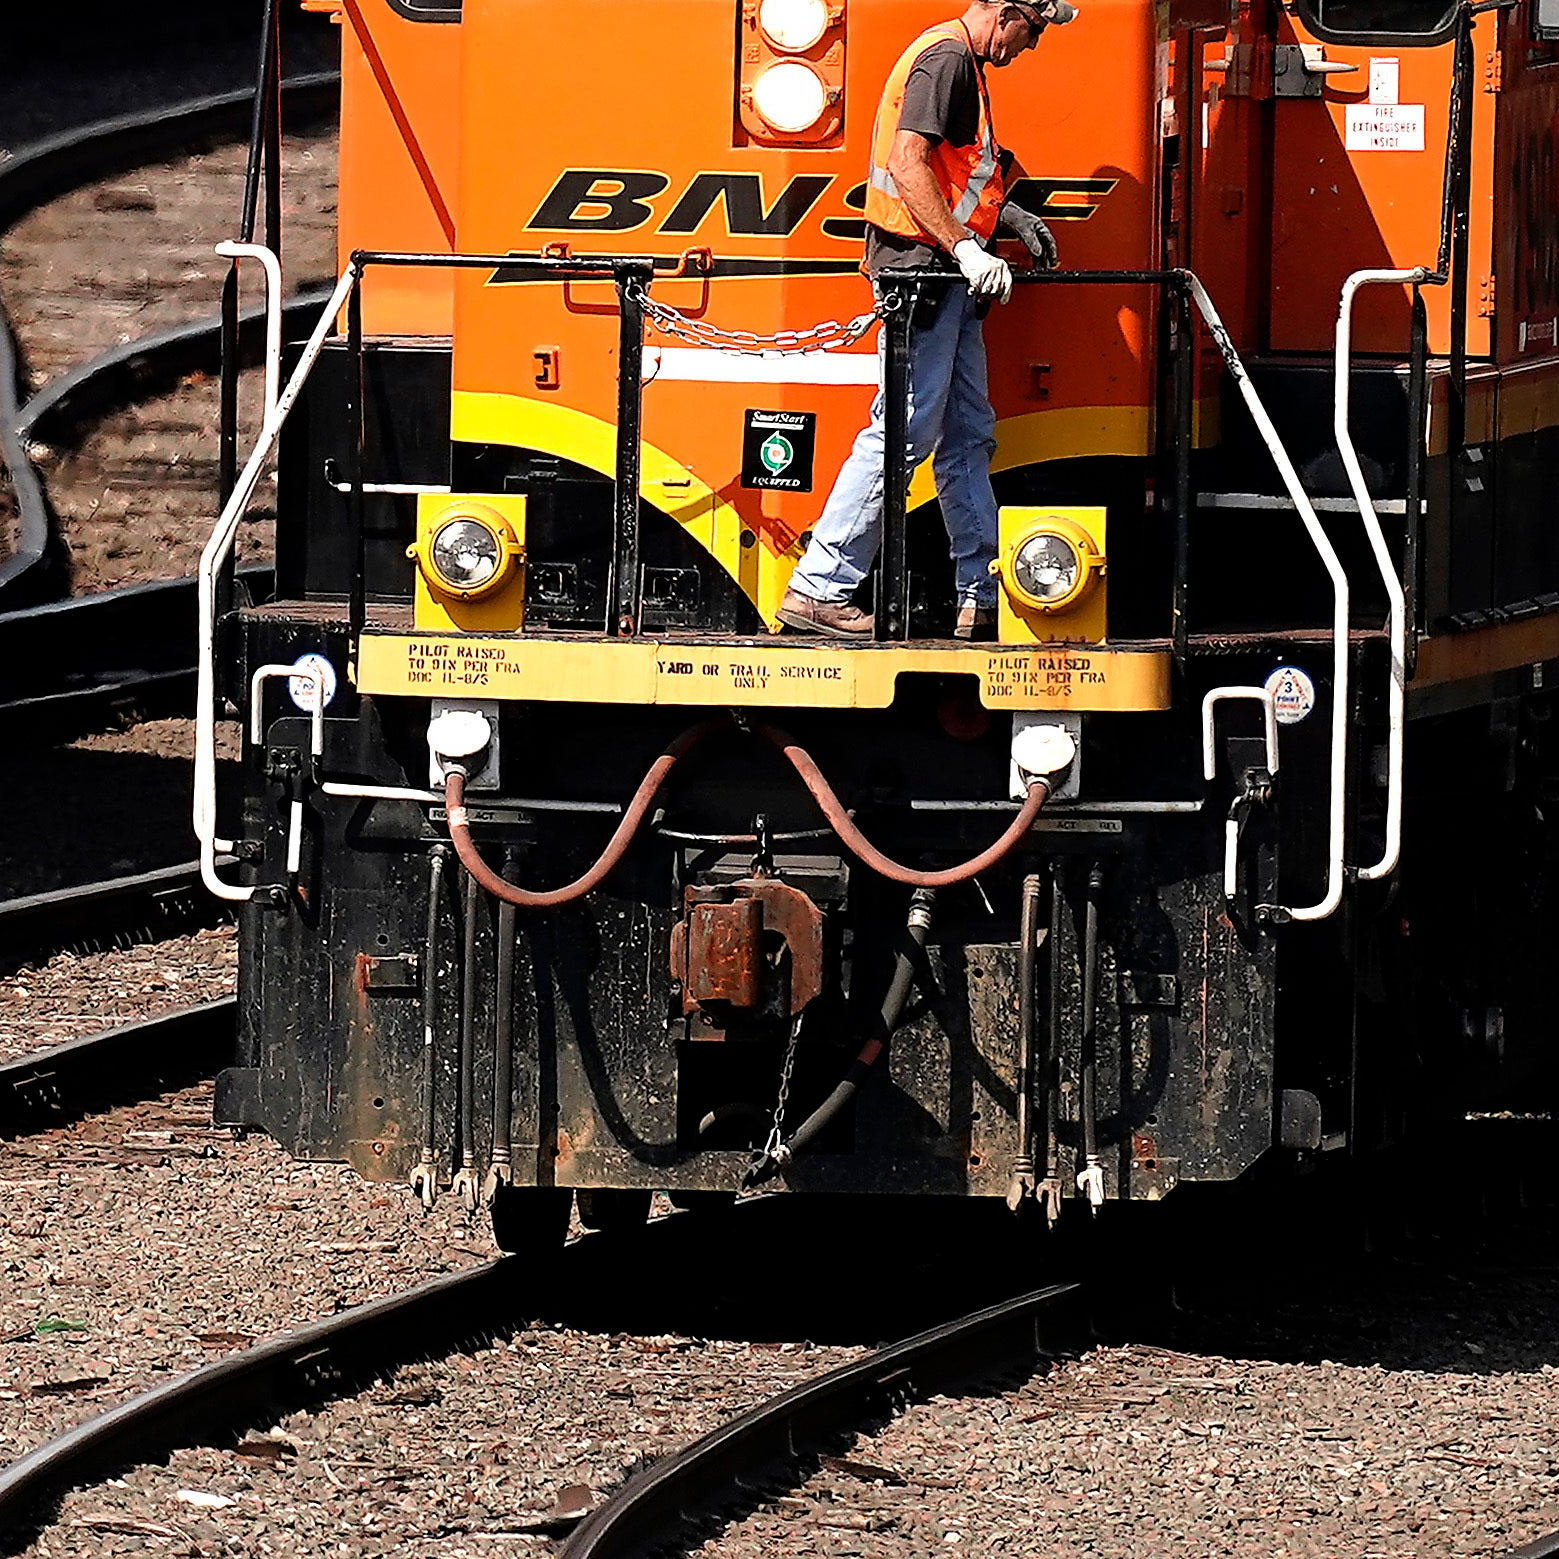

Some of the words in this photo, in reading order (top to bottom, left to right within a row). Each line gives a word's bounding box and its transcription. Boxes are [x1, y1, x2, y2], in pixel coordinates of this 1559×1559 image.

[1374, 106, 1394, 118] FIRE
[1352, 122, 1417, 133] EXTINGUISHER
[1369, 136, 1399, 148] INSIDE
[521, 169, 1121, 243] BNF
[408, 643, 450, 657] PILOT
[457, 646, 505, 660] RAISED
[408, 658, 425, 670] TO
[464, 660, 488, 673] PER
[495, 662, 521, 674] FRA
[656, 660, 694, 675] YARD
[702, 664, 719, 676] OR
[780, 665, 842, 680] SERVICE
[987, 657, 1030, 670] PILOT
[1038, 657, 1091, 670] RAISED
[407, 671, 432, 683] DOC
[733, 676, 769, 689] ONLY
[987, 671, 1005, 683] TO
[1046, 672, 1071, 684] PER
[1080, 672, 1106, 684] FRA
[987, 685, 1013, 696] DOC
[1284, 681, 1293, 693] 3
